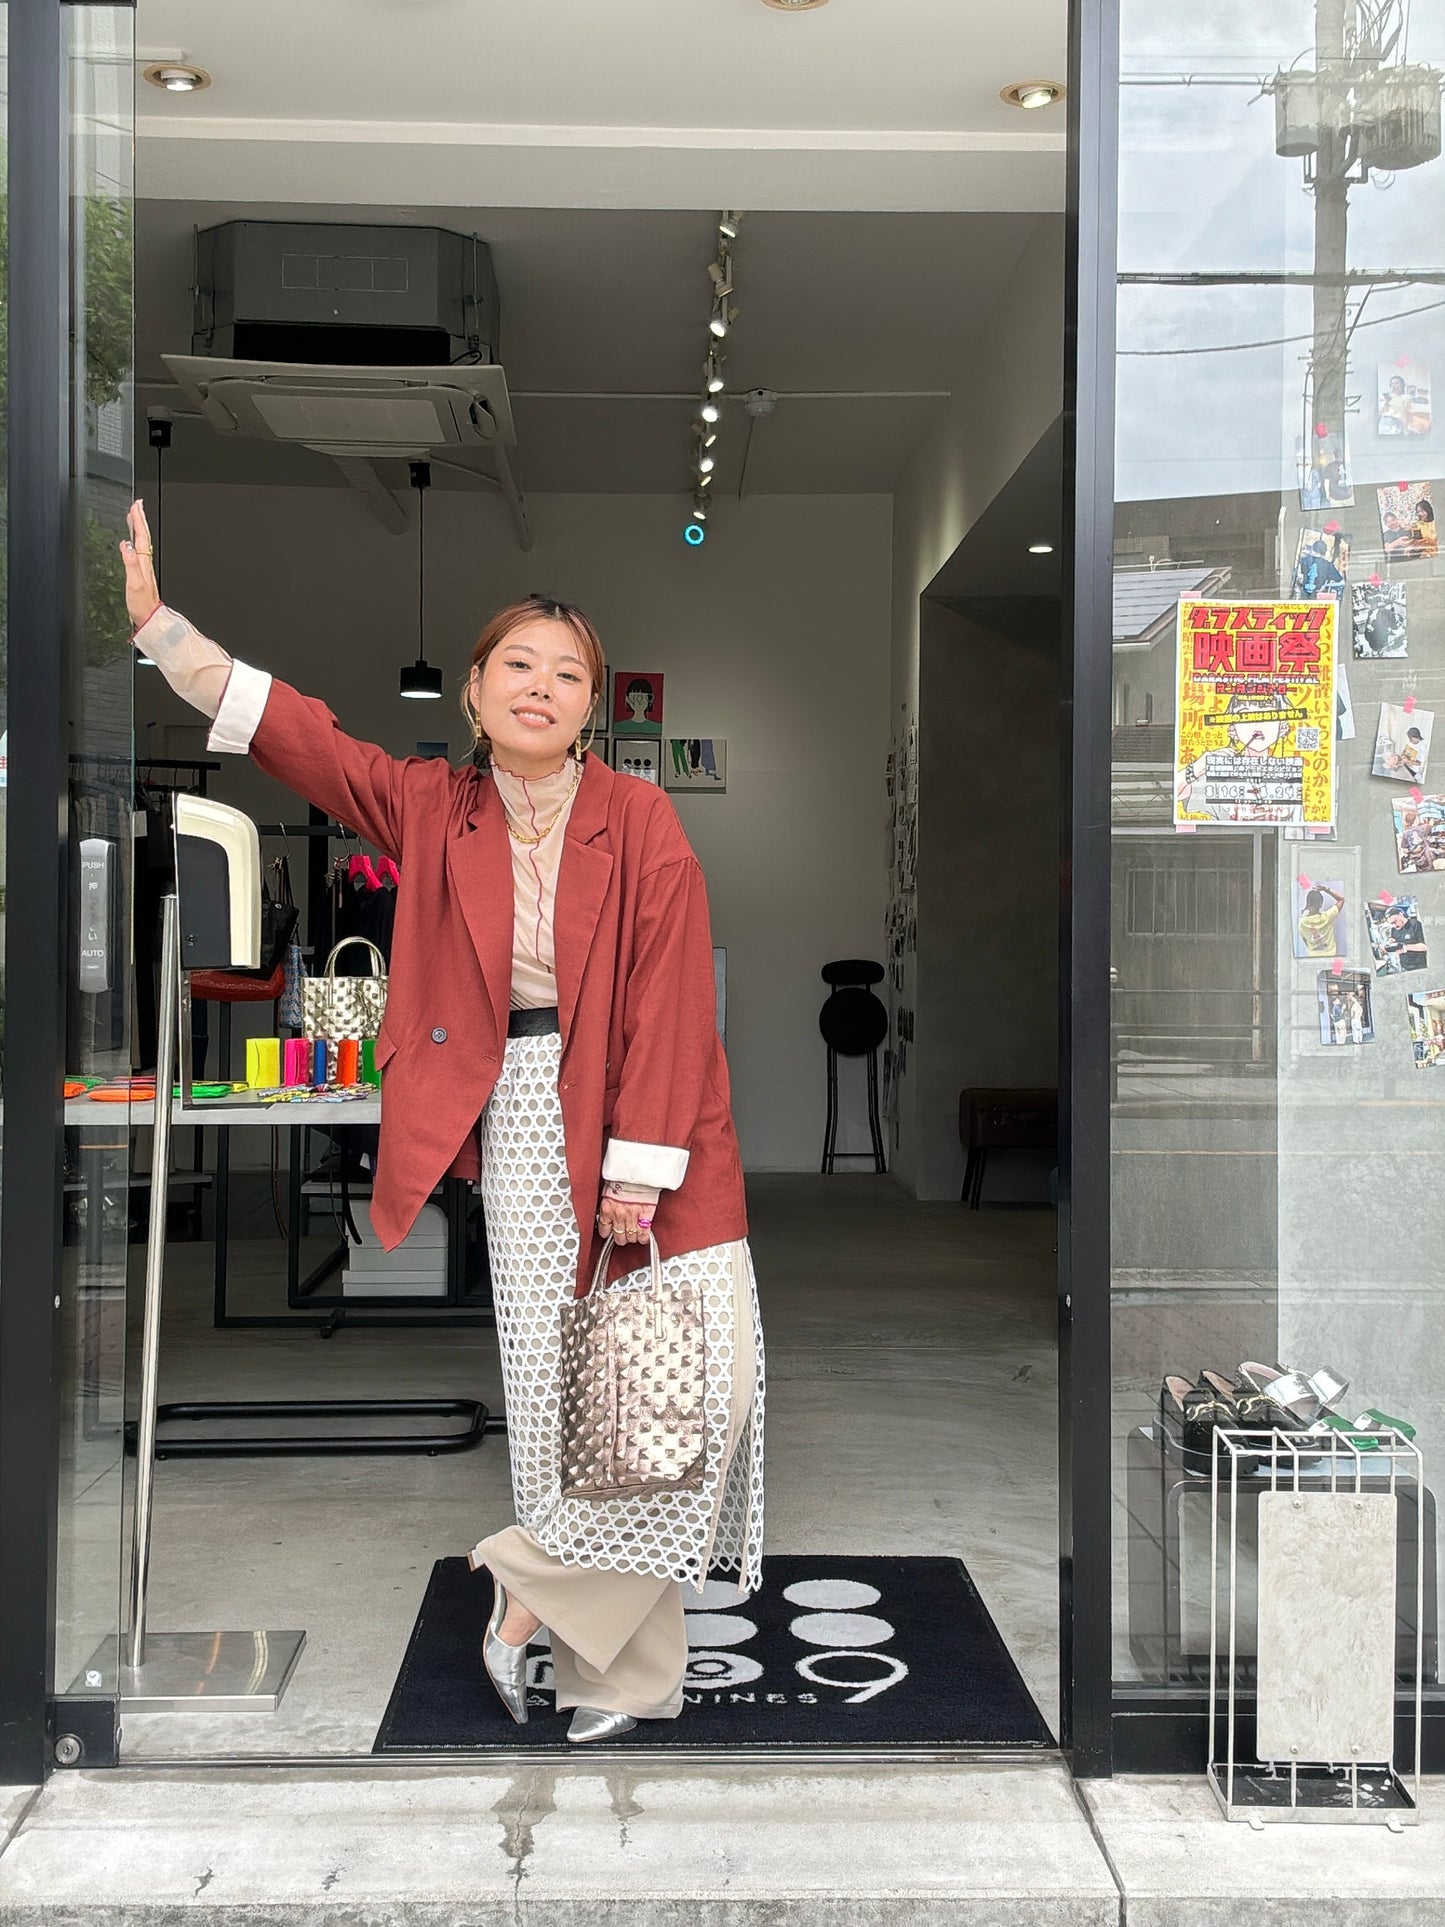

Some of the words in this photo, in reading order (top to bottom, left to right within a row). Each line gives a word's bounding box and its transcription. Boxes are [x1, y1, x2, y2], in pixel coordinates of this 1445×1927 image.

[1193, 630, 1321, 673] 映画祭
[1193, 673, 1245, 684] DARASTIC
[1247, 673, 1271, 684] FILM
[1272, 673, 1320, 684] FESTIVAL
[82, 861, 105, 869] PUSH
[81, 949, 104, 957] AUTO
[794, 1650, 909, 1704] 9
